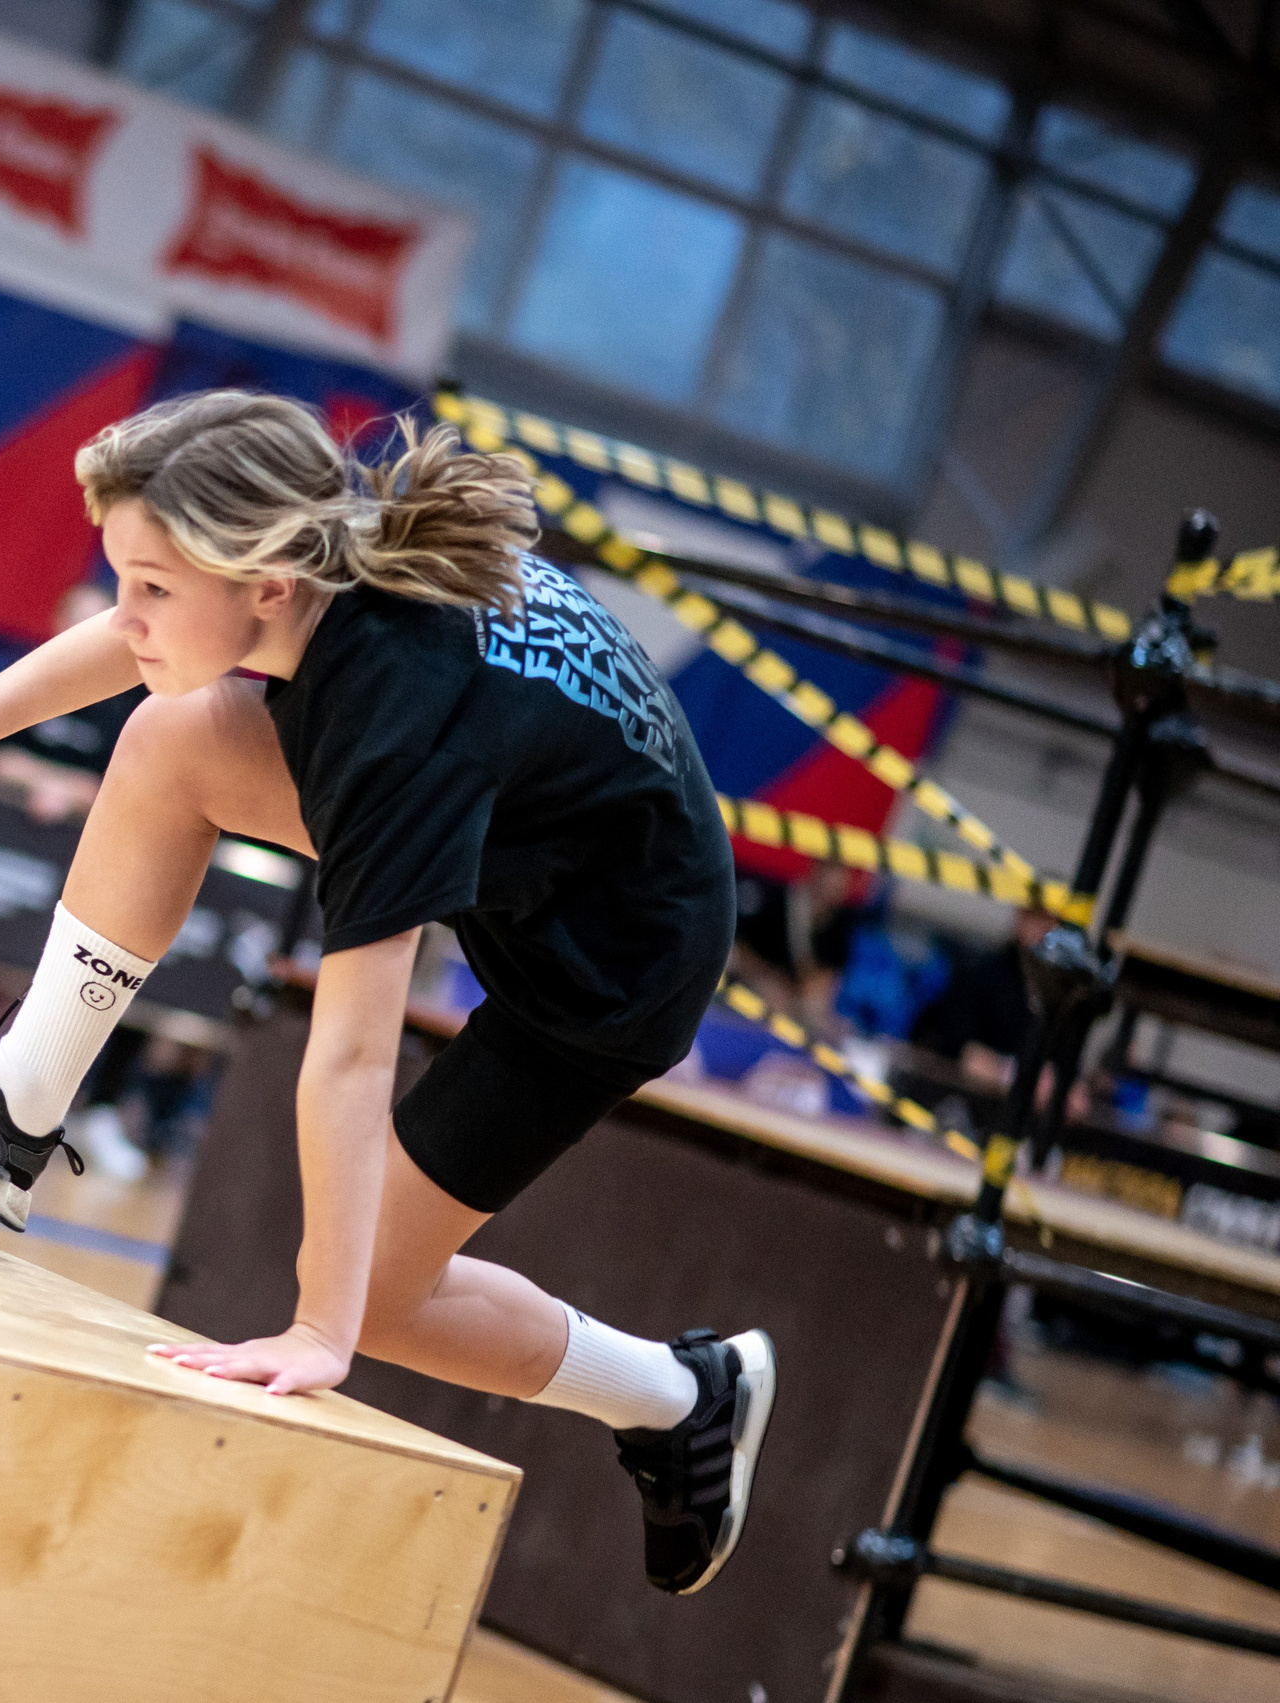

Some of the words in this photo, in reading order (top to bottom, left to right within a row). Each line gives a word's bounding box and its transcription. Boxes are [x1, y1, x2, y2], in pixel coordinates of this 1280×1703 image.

[524, 610, 565, 681] FLY
[554, 614, 592, 707] FLY
[583, 617, 622, 719] FLY
[73, 944, 144, 990] ZONE
